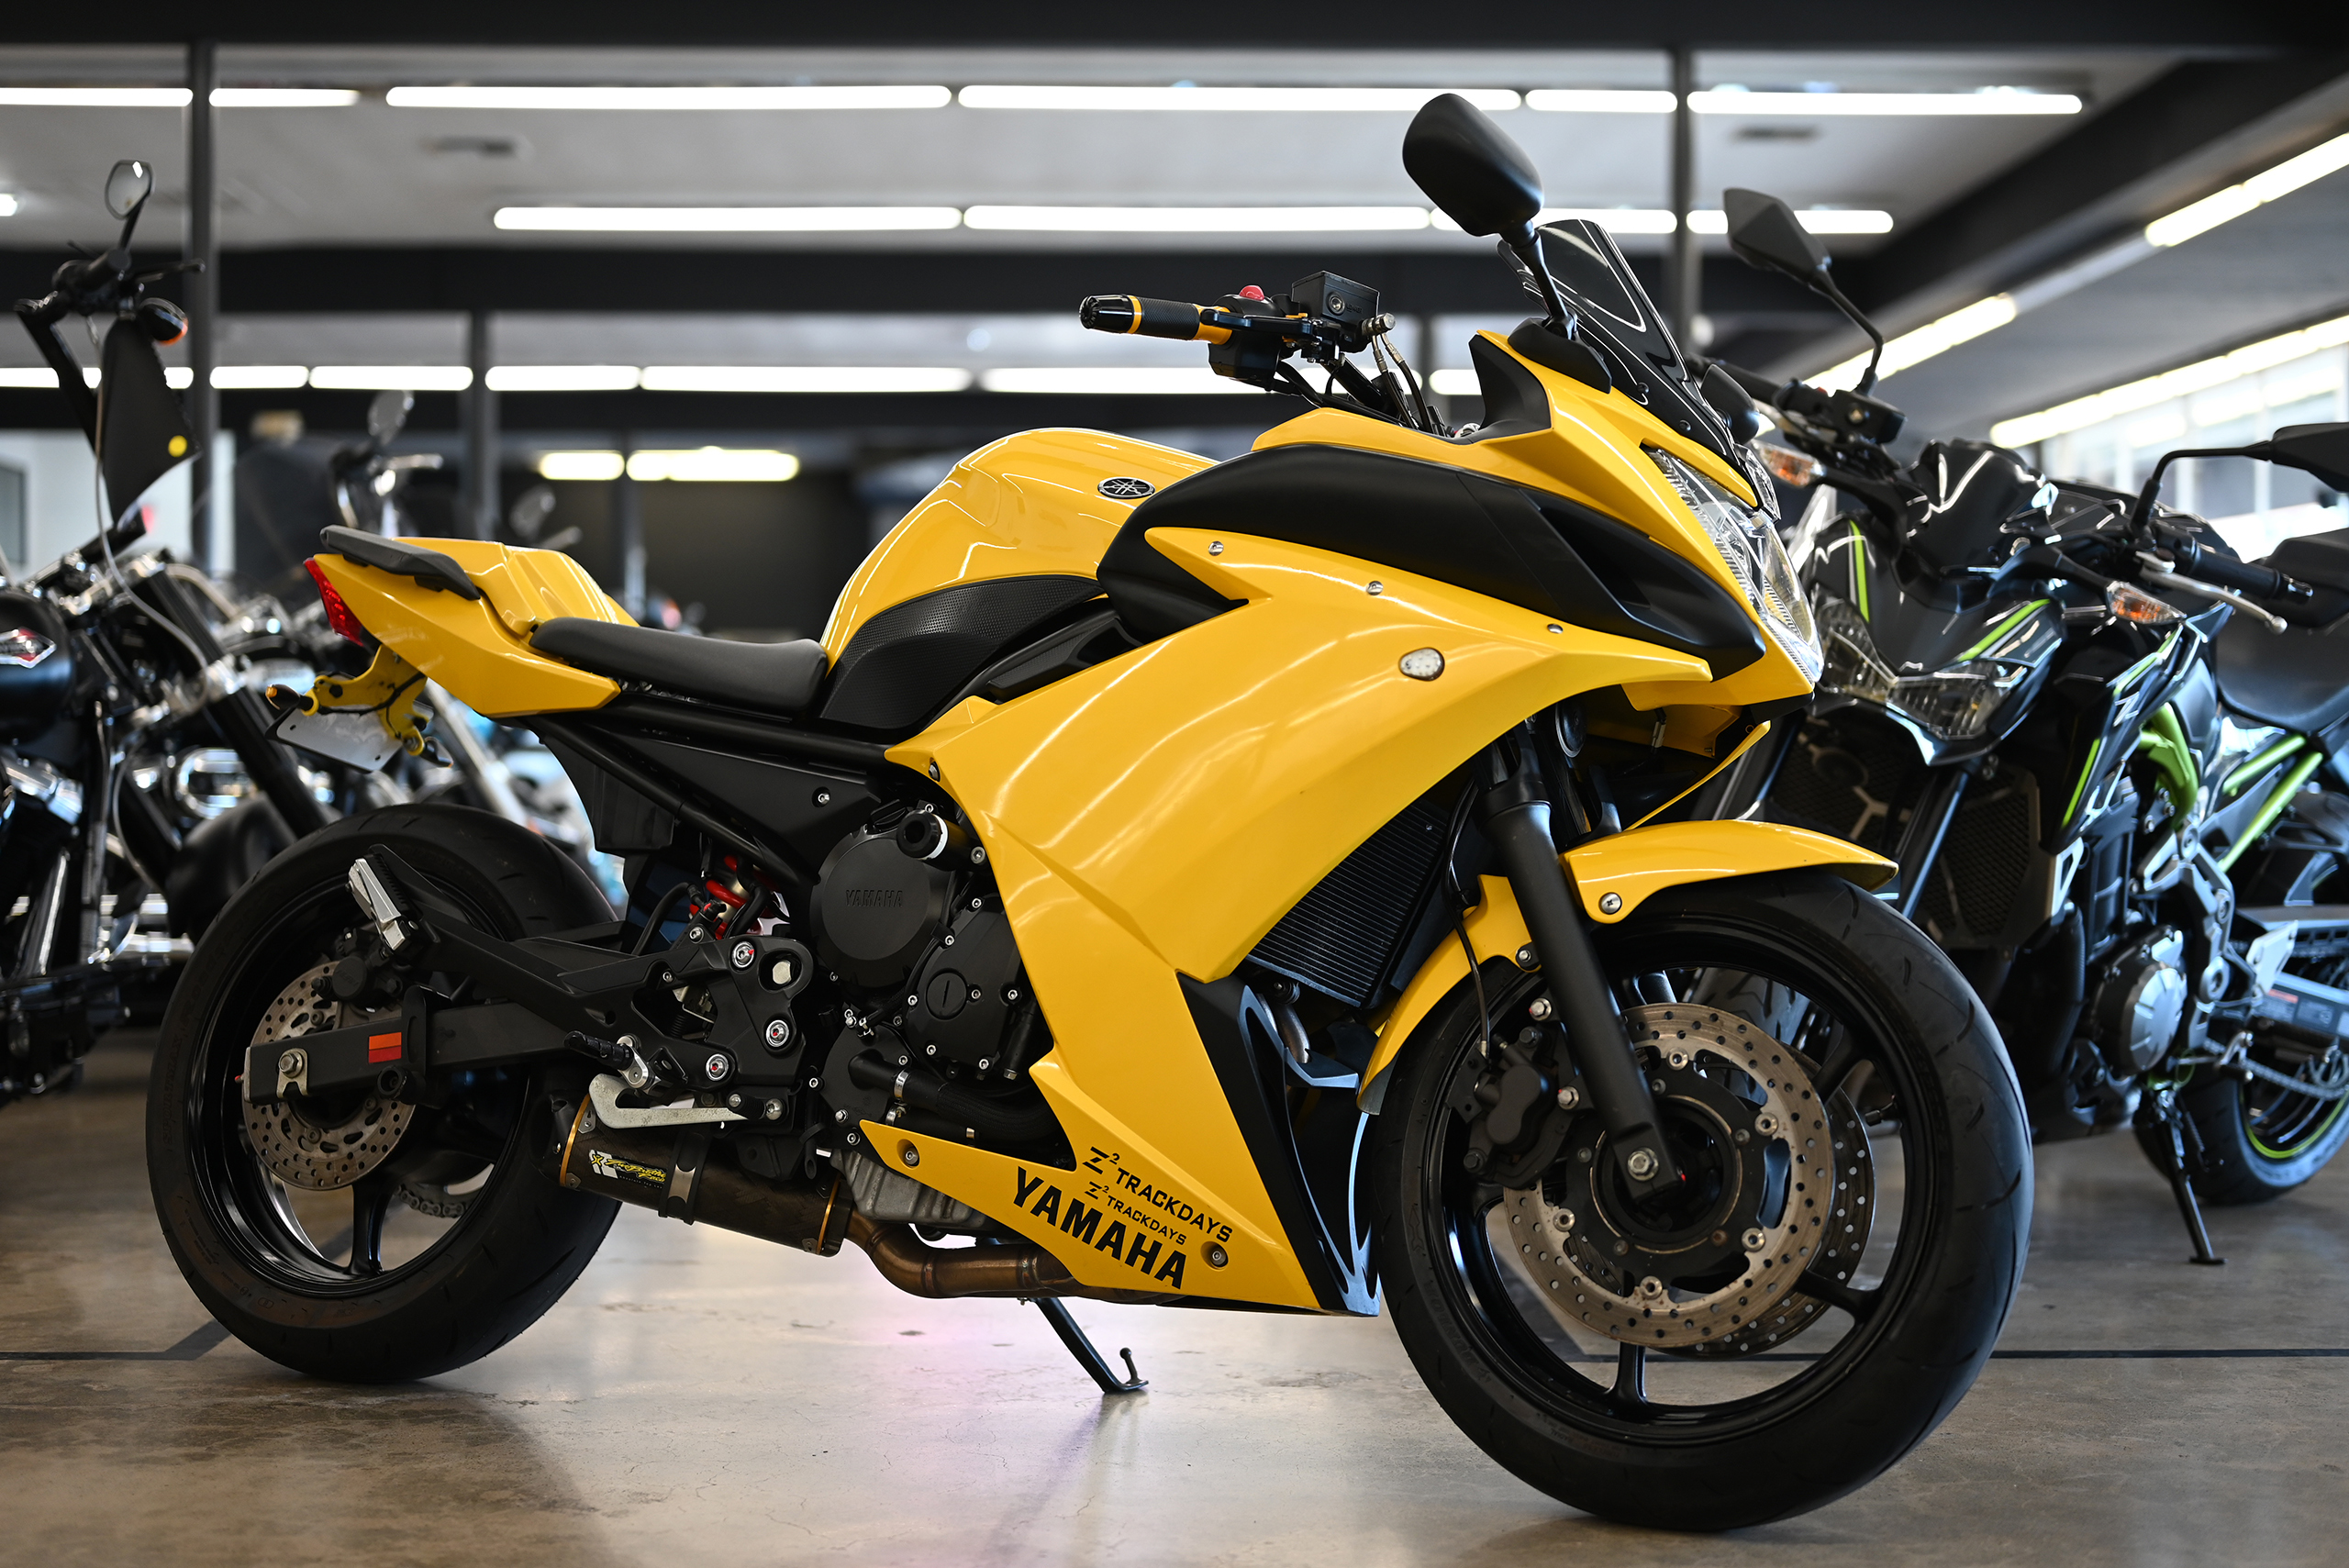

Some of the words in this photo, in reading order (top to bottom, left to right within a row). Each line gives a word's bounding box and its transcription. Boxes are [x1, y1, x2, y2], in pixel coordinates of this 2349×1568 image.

[845, 889, 903, 907] YAMAHA
[1013, 1165, 1186, 1290] YAMAHA
[1107, 1195, 1187, 1246] TRACKDAYS
[1115, 1167, 1233, 1243] TRACKDAYS
